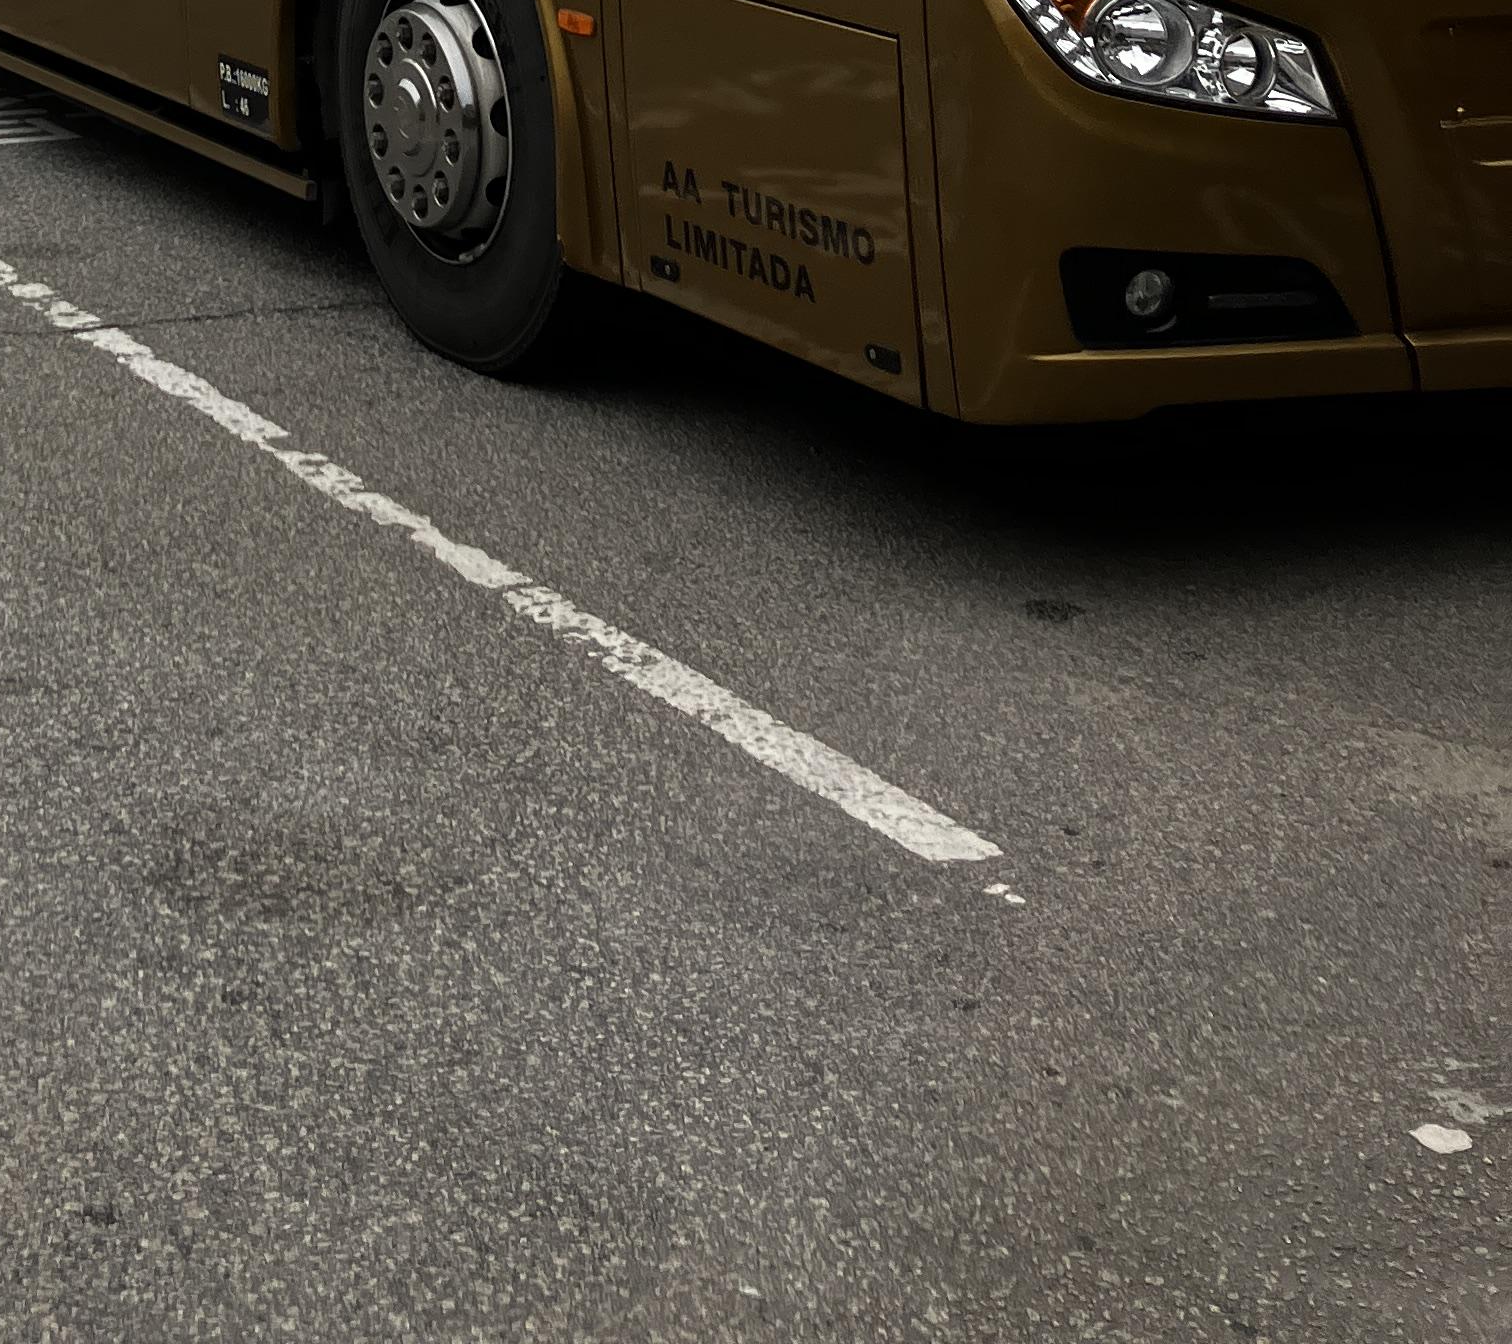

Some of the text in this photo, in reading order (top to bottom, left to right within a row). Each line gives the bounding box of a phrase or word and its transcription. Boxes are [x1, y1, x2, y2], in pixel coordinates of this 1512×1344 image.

[662, 160, 877, 266] AA TURISMO
[664, 214, 818, 304] LIMITADA
